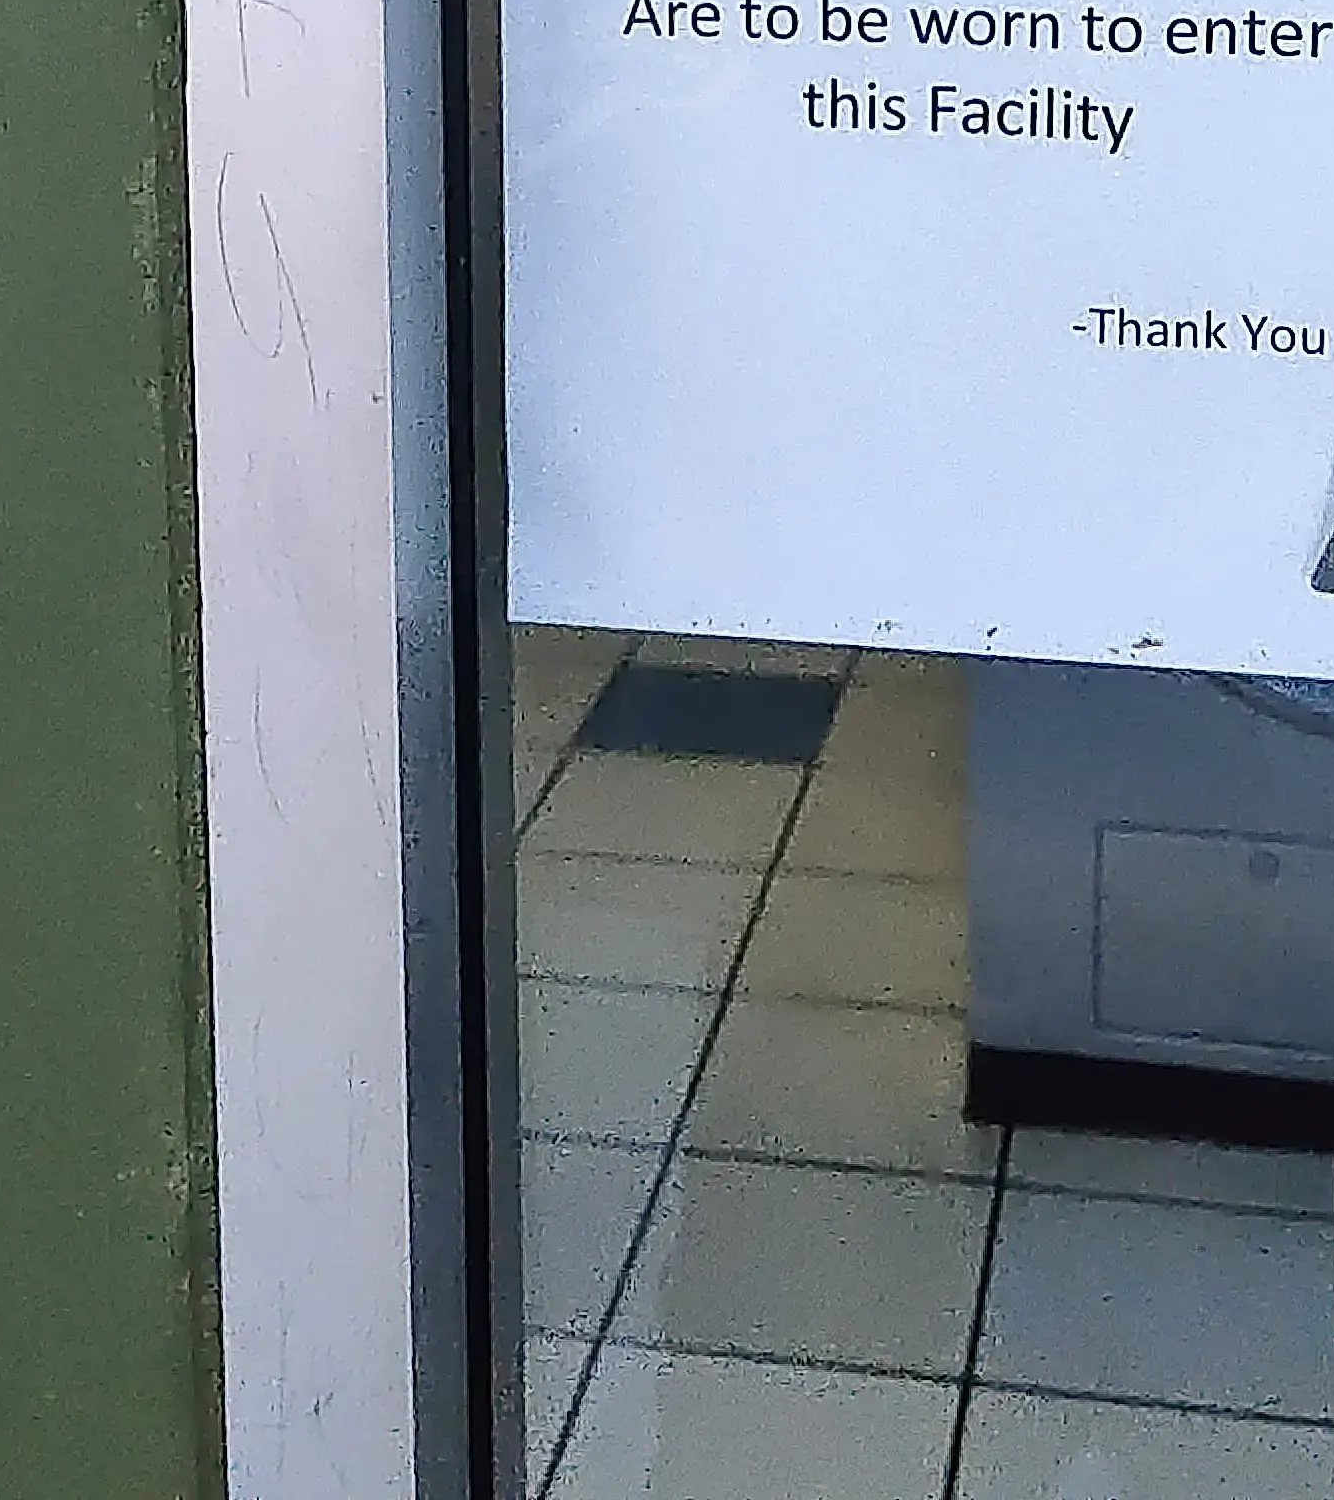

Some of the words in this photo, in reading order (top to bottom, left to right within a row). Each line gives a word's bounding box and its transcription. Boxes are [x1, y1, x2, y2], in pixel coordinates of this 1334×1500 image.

[909, 8, 1060, 50] worn
[1081, 6, 1143, 54] to
[1165, 9, 1334, 59] enter
[802, 77, 907, 133] this
[929, 85, 1135, 155] Facility
[1072, 307, 1229, 350] -Thank
[1240, 314, 1326, 357] You
